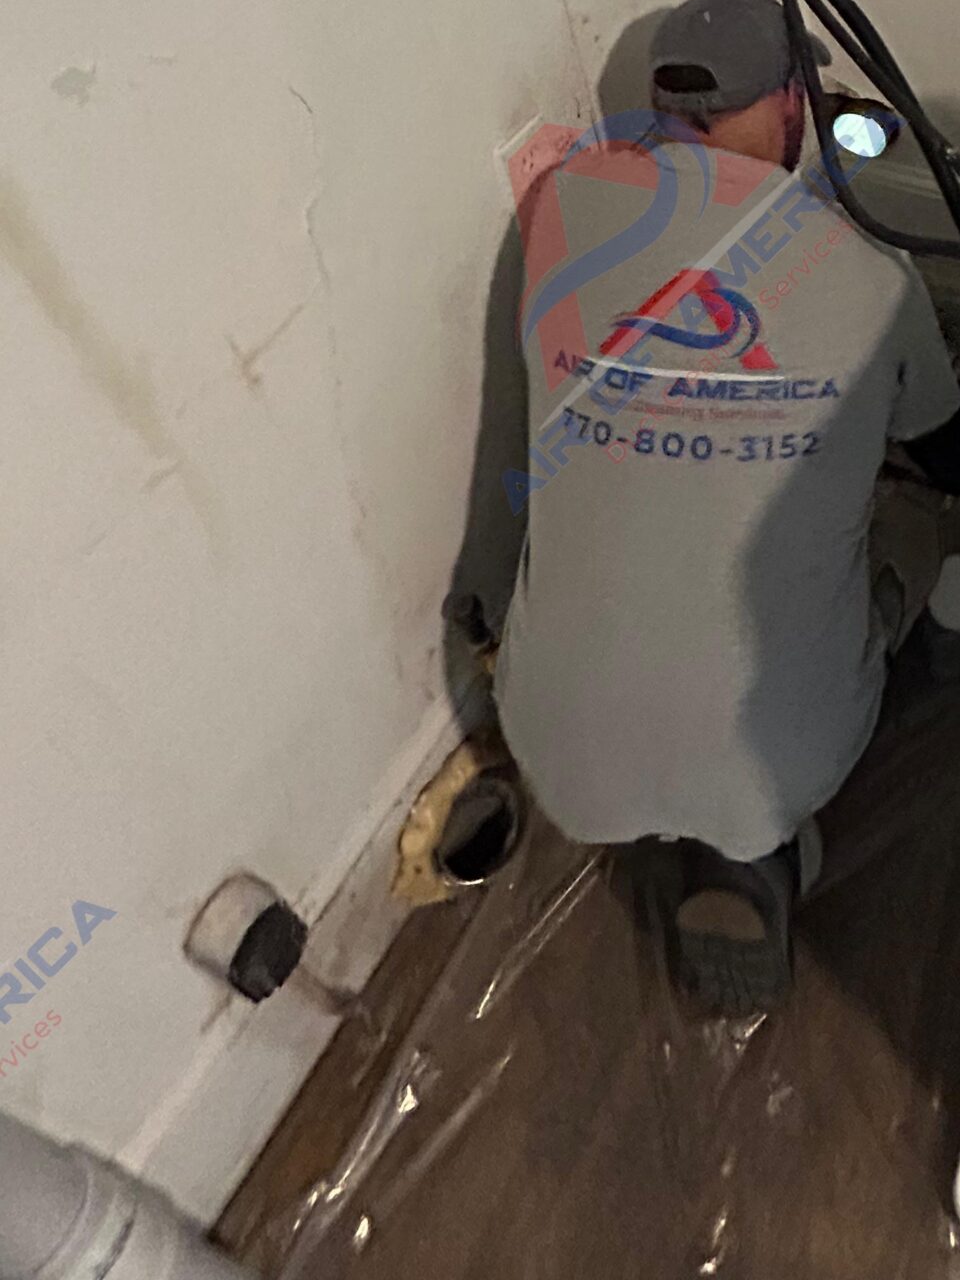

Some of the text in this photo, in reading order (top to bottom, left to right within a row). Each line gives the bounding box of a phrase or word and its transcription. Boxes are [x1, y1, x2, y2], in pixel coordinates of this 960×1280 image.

[603, 366, 652, 391] OF
[667, 376, 840, 402] AMERICA
[563, 406, 822, 462] 770-800-3152
